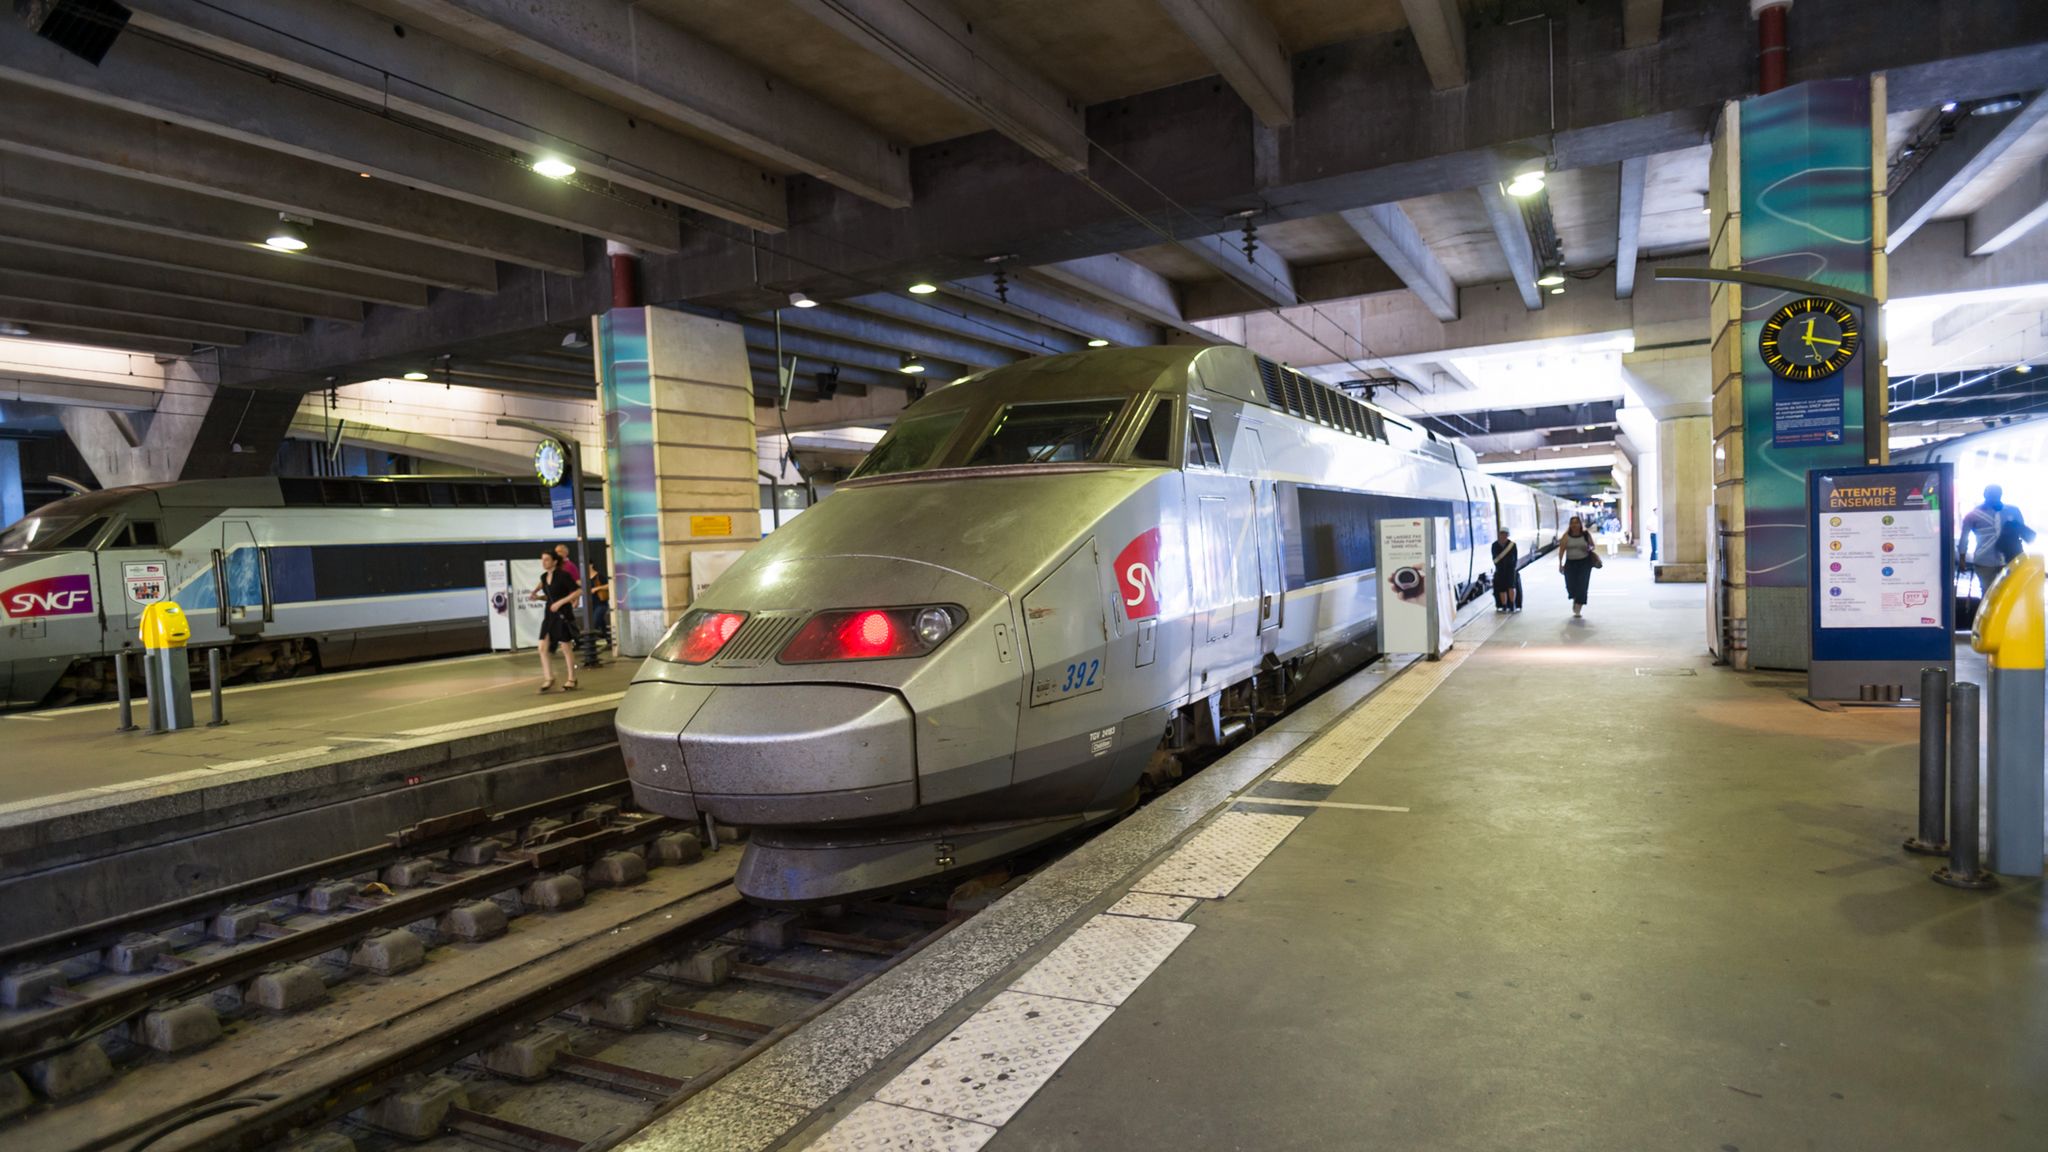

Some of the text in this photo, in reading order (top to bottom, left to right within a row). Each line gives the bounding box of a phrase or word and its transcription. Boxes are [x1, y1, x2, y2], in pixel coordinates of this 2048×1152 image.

[1830, 487, 1897, 497] ATTENTIFS
[1830, 497, 1897, 508] ENSEMBLE
[1126, 561, 1160, 606] SN
[11, 590, 89, 613] SNCF
[1062, 659, 1099, 692] 392
[1089, 731, 1101, 741] TGV
